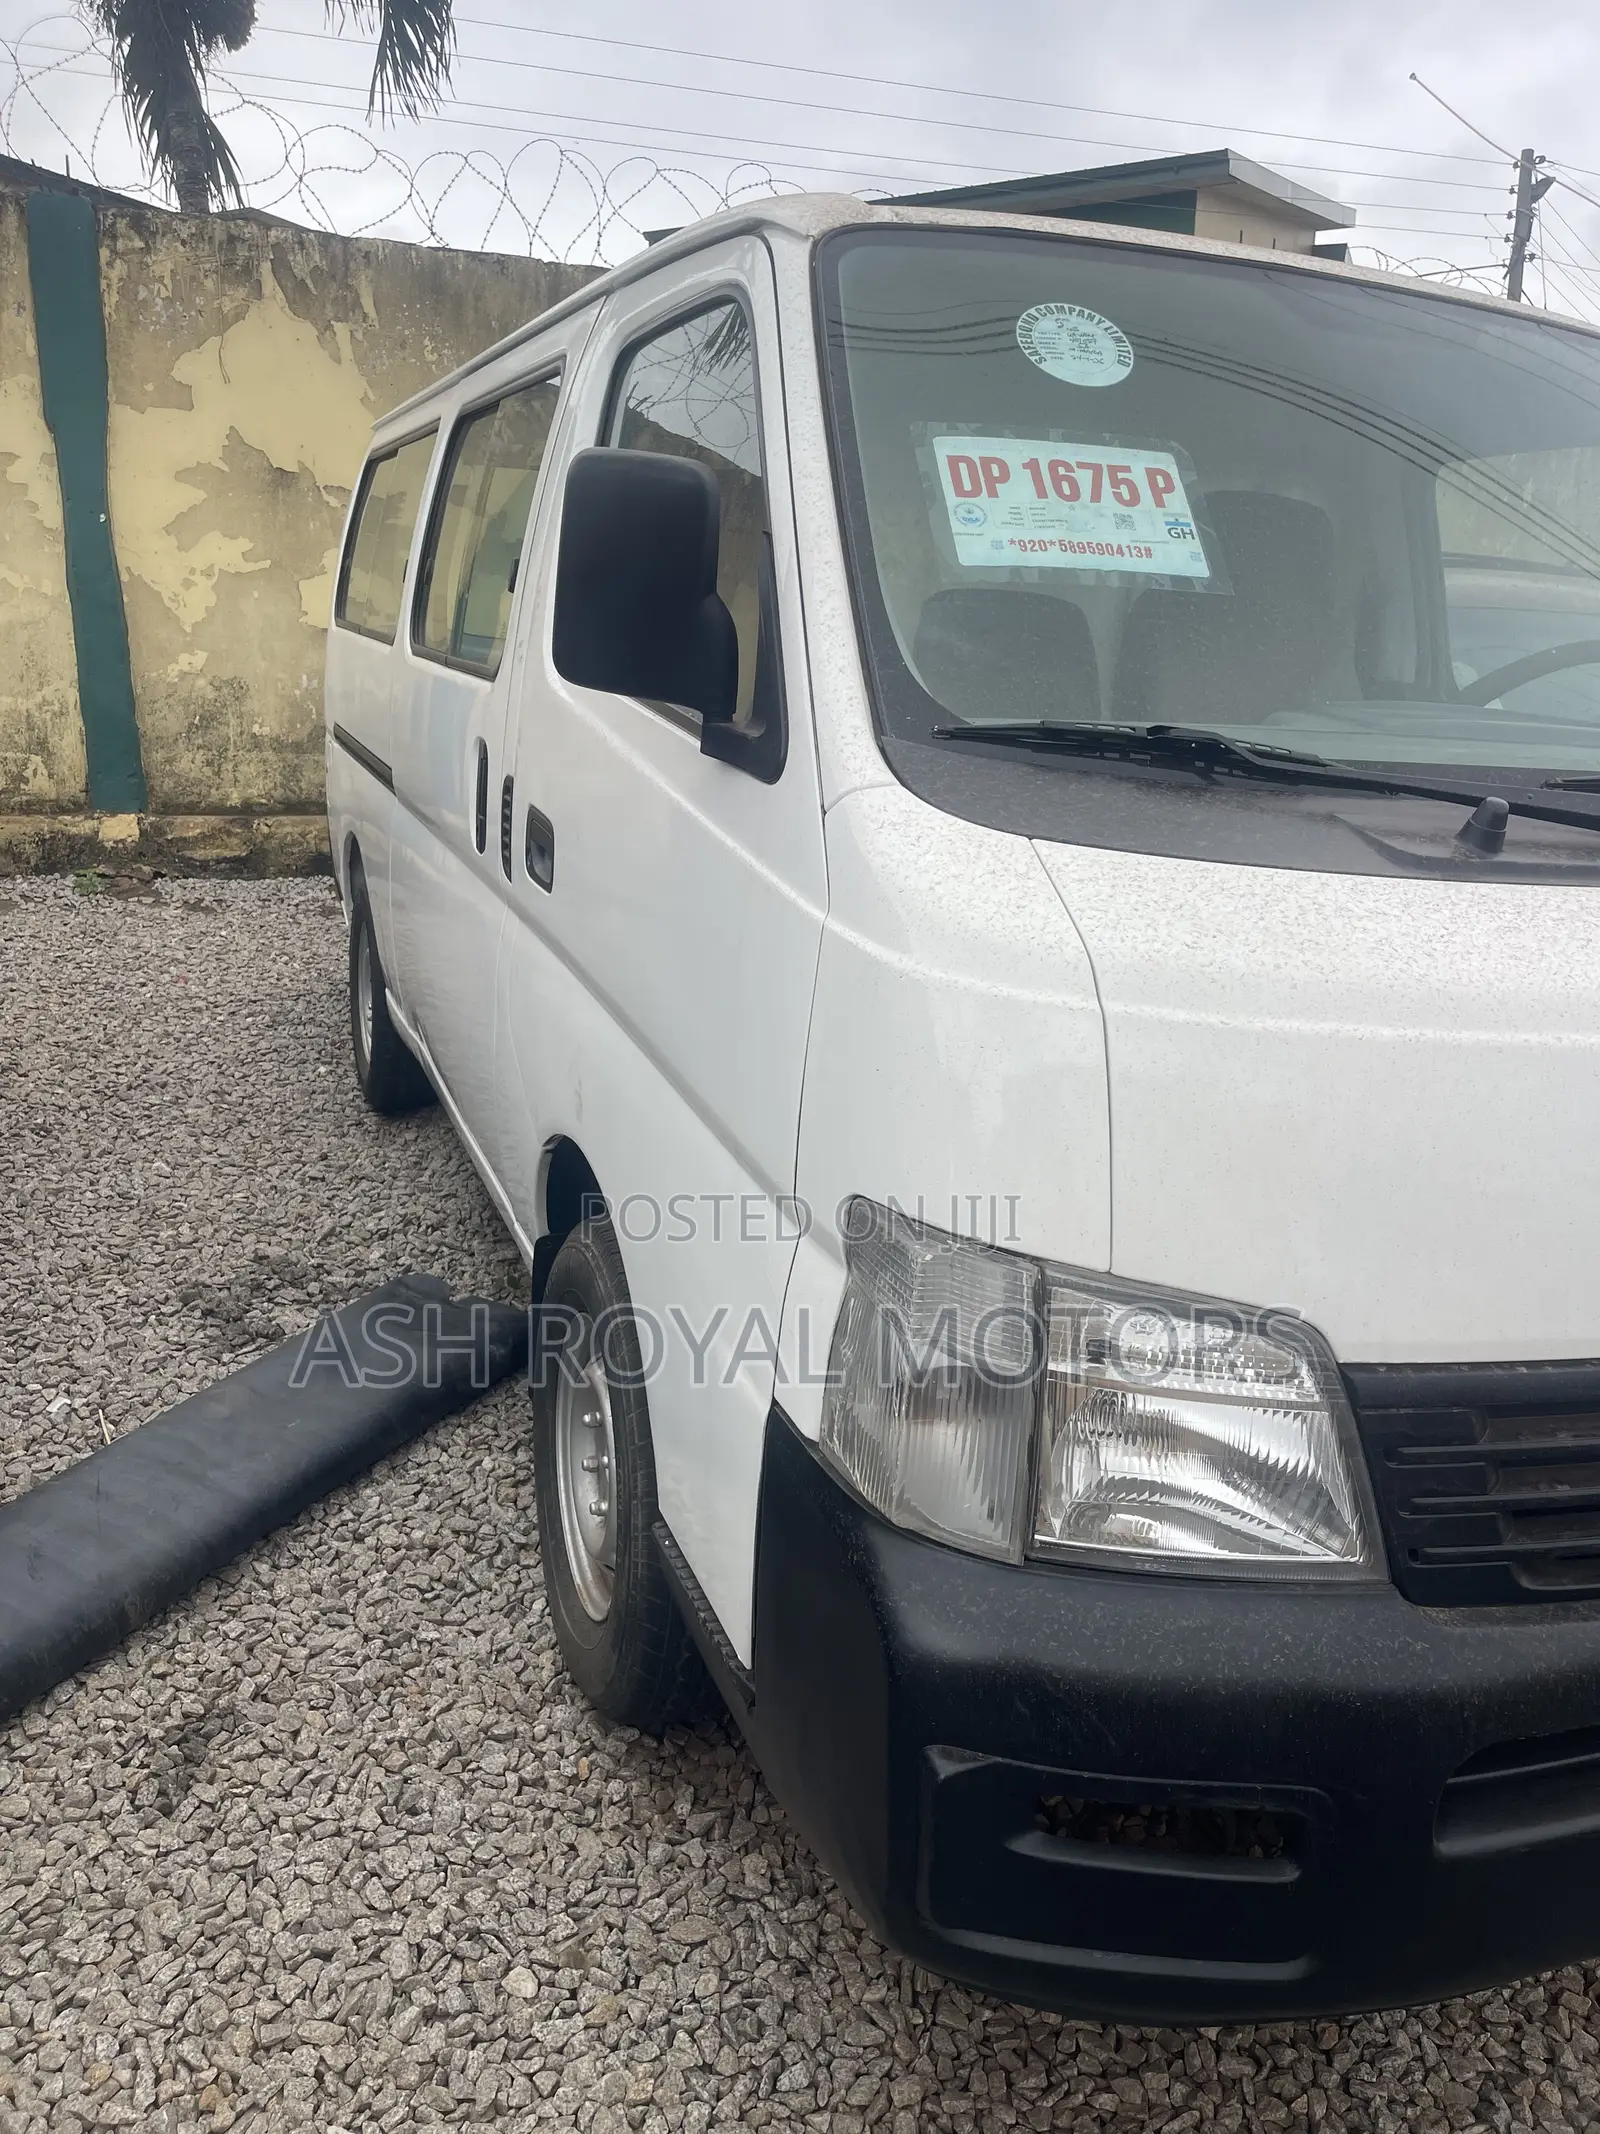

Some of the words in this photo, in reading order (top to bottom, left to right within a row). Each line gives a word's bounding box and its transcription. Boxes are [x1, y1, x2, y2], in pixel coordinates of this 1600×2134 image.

[1018, 312, 1047, 365] SAFEBOND
[1034, 304, 1106, 326] COMPANY
[1103, 325, 1132, 368] LIMITED
[946, 455, 1011, 498] DP
[1022, 457, 1141, 507] 1675
[1143, 466, 1176, 509] P
[1167, 527, 1196, 540] GH
